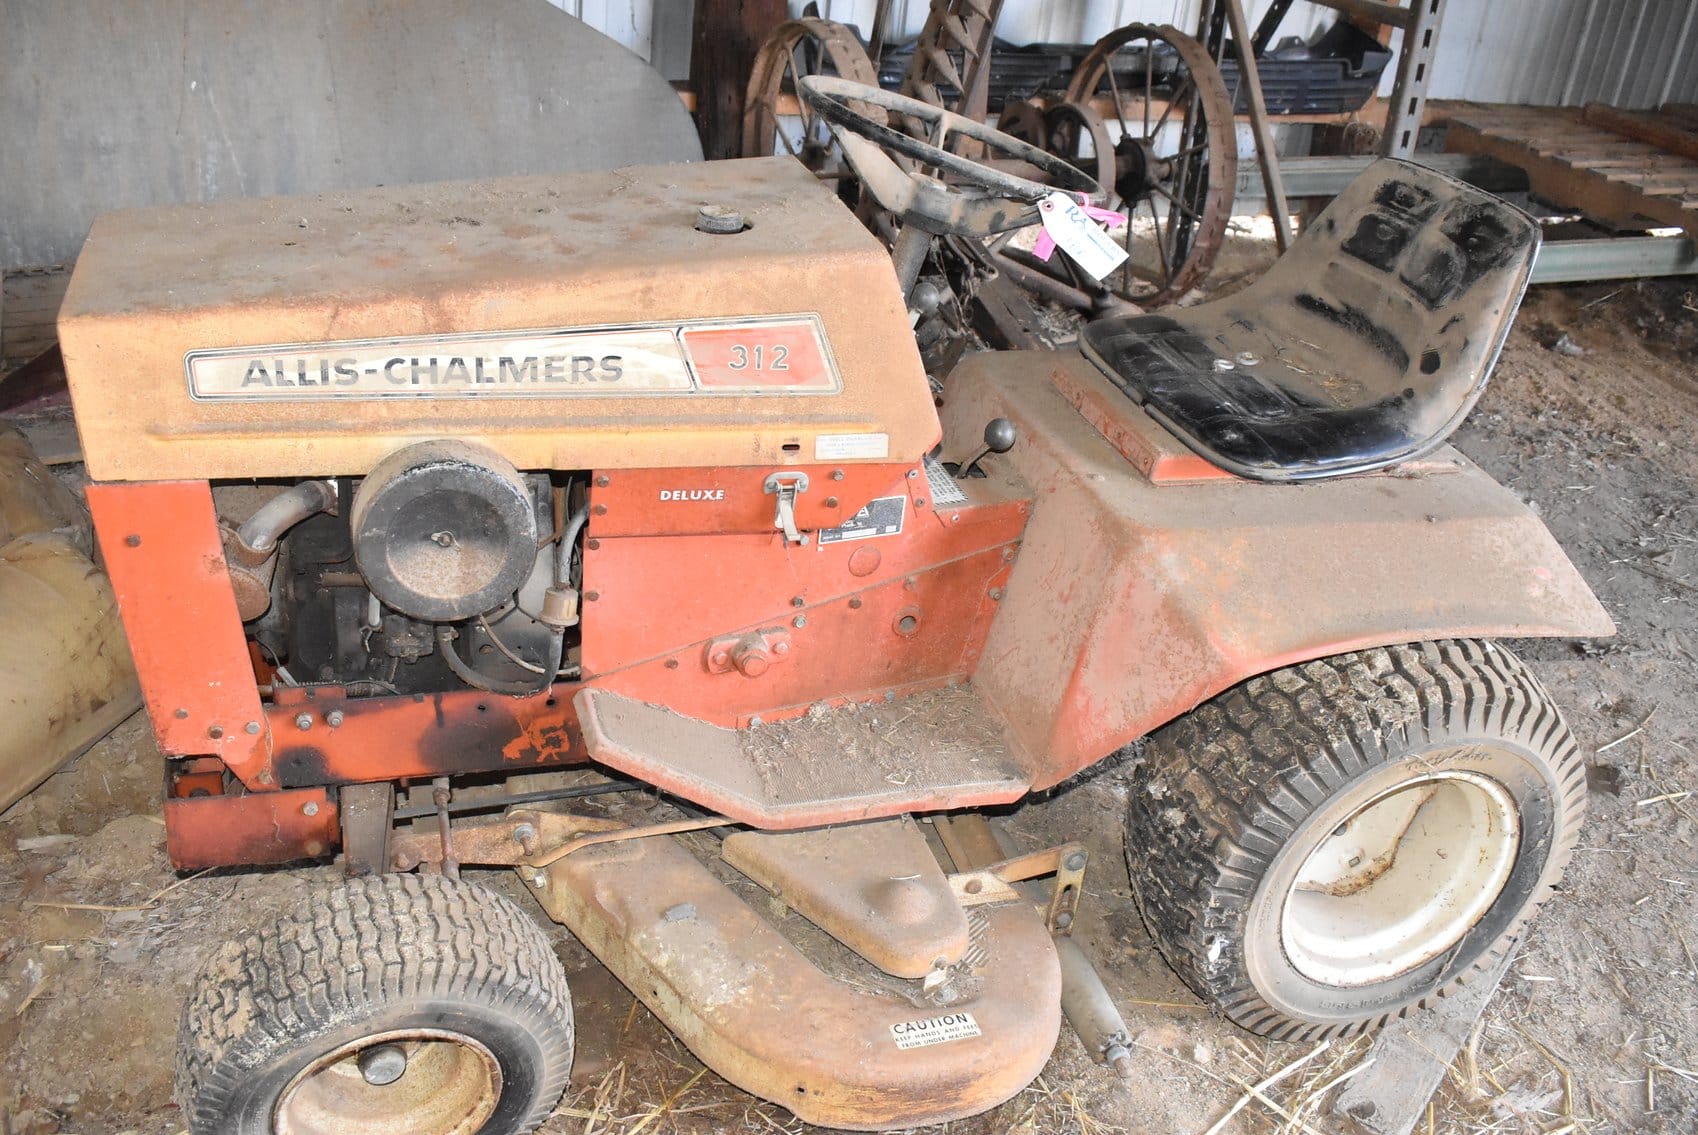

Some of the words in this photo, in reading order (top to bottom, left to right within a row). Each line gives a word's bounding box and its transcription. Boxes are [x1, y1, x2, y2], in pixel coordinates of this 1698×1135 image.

[728, 344, 789, 370] 312
[241, 355, 623, 388] ALLIS-CHALMERS
[660, 489, 725, 501] DELUXE
[893, 1014, 968, 1034] CAUTION
[895, 1034, 911, 1043] KEEP
[915, 1030, 941, 1039] HANDS
[944, 1025, 960, 1034] AND
[949, 1031, 978, 1039] MACHINE
